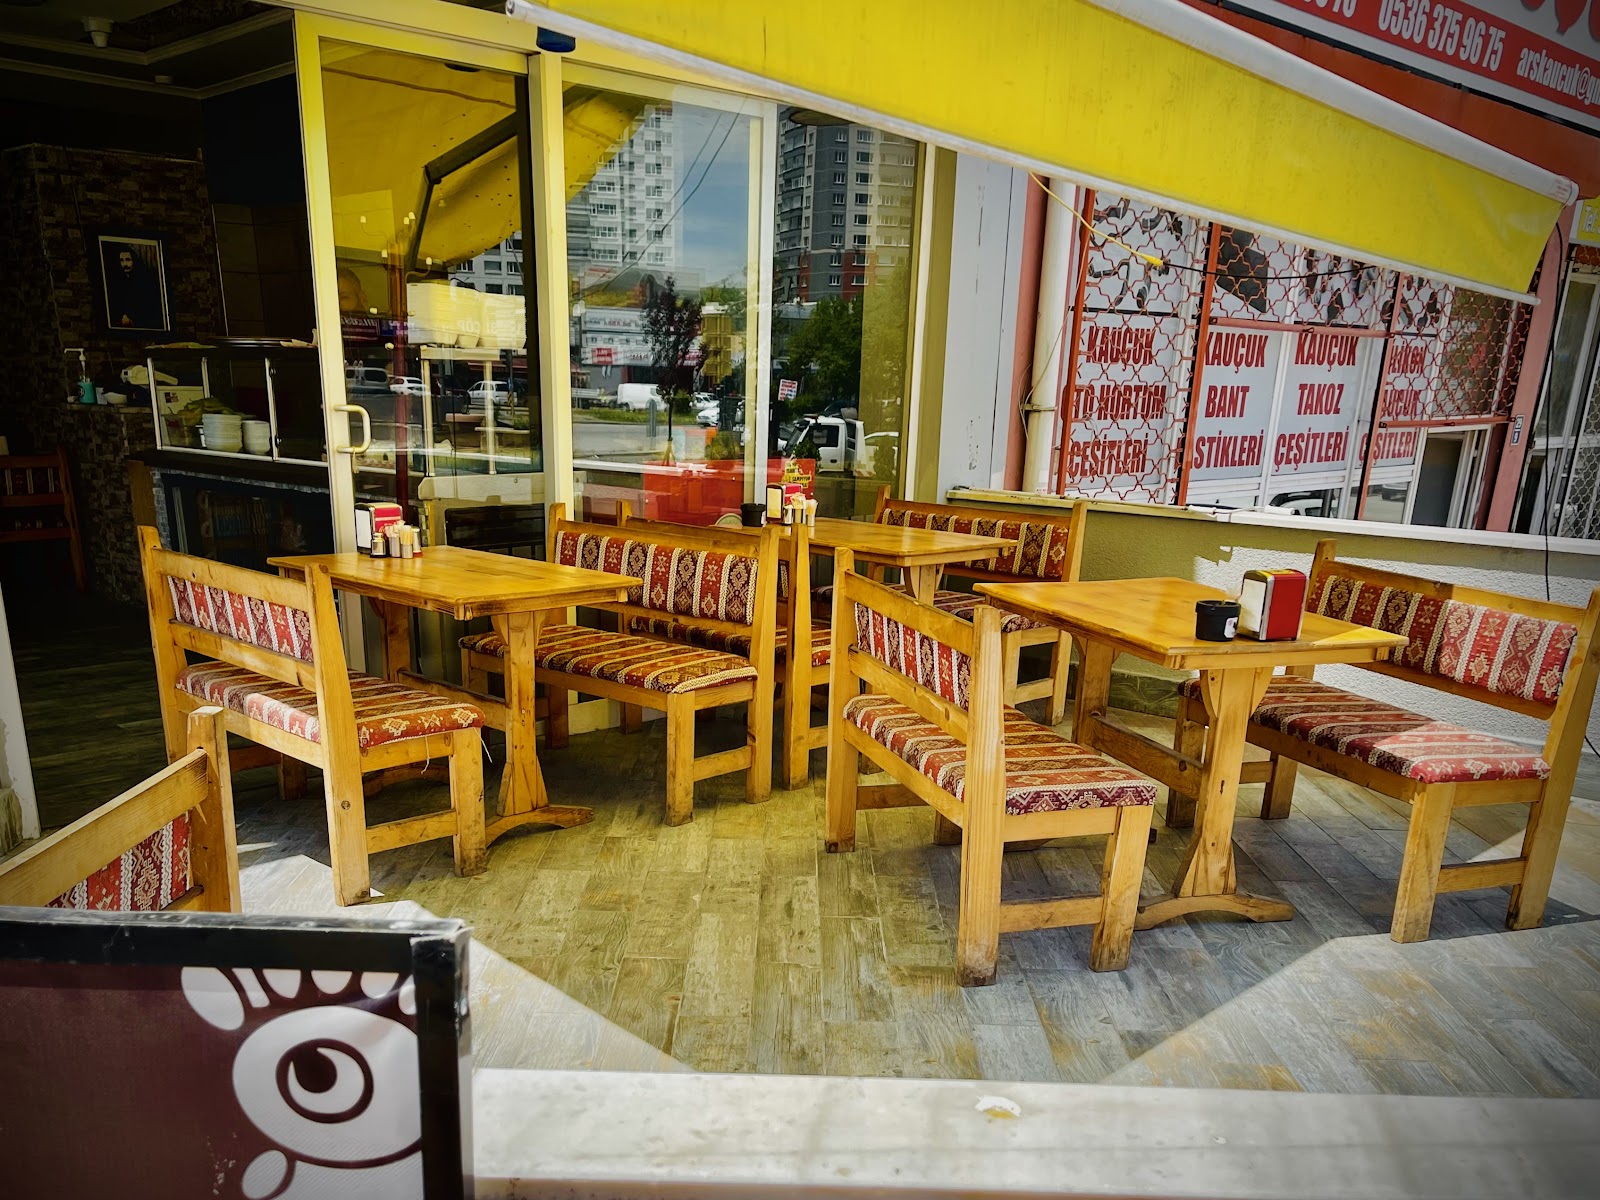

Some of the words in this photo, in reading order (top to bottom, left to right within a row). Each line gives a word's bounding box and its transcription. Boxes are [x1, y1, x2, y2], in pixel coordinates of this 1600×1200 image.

[1378, 0, 1430, 44] 0536
[1427, 4, 1463, 56] 375
[1459, 17, 1487, 65] 96
[1482, 26, 1506, 72] 75
[1086, 326, 1155, 371] KAUÇUK
[1294, 332, 1359, 372] KAUÇUK
[1204, 385, 1250, 418] BANT
[1296, 383, 1344, 415] TAKOZ
[1381, 389, 1420, 421] AUÇUK
[1174, 429, 1264, 470] STİKLERİ
[1274, 426, 1349, 472] ÇEŞİTLERİ
[1359, 427, 1418, 467] ÇŞİTLERİ
